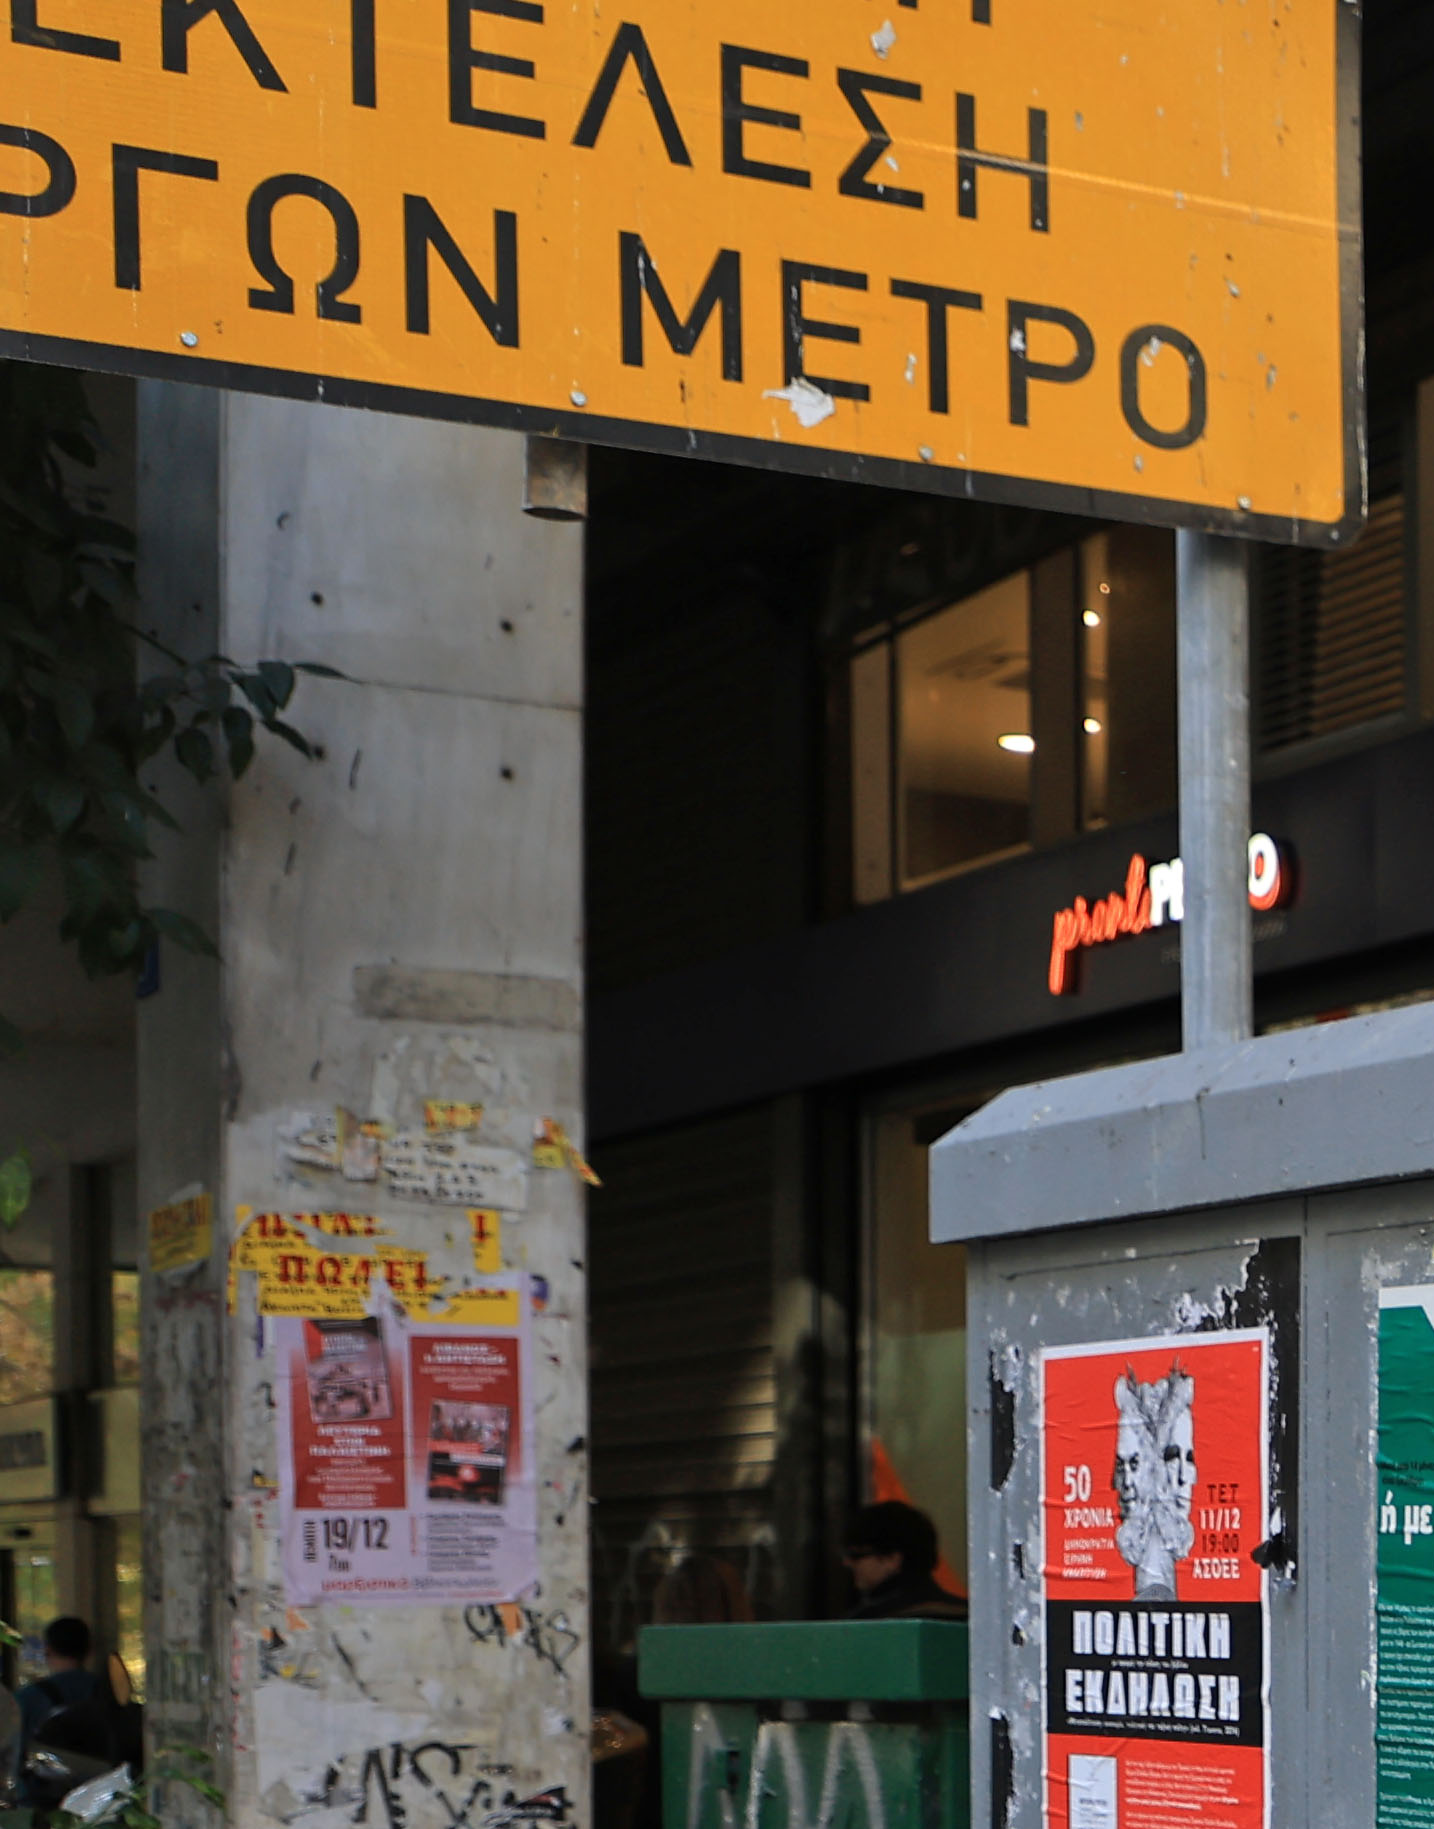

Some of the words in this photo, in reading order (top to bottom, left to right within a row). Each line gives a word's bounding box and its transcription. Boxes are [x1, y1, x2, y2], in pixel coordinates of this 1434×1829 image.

[619, 230, 1208, 451] ΜΕΤΡΟ
[1063, 1463, 1093, 1504] 50
[1206, 1482, 1240, 1504] ΤΕΤ
[322, 1516, 389, 1553] 19/12
[1063, 1506, 1115, 1530] ΧΡΟΝΙΑ
[1199, 1507, 1241, 1531] 11/12
[1379, 1489, 1397, 1535] ή
[1403, 1503, 1434, 1546] με
[1200, 1533, 1240, 1554] 19:00
[1192, 1556, 1241, 1580] ΑΣΟΕΕ
[1072, 1609, 1231, 1660] ΠΟΛΙΤΙΚΗ
[1065, 1667, 1241, 1722] ΕΚΔΗΛΩΣΗ
